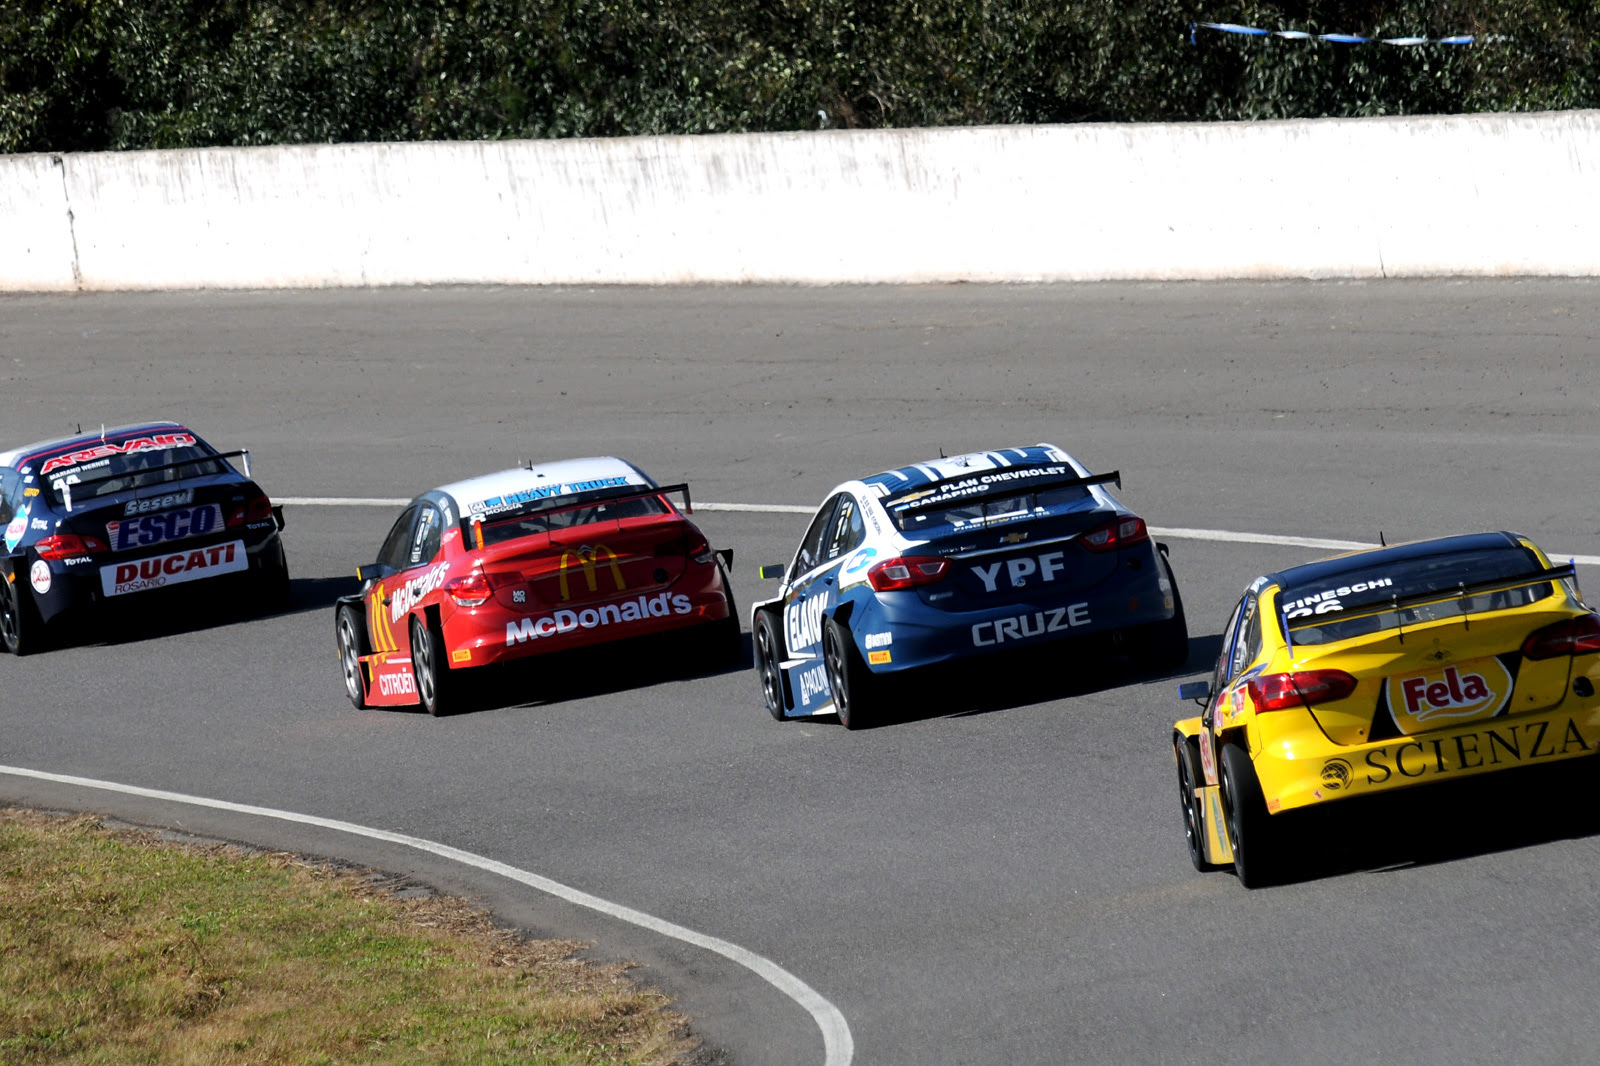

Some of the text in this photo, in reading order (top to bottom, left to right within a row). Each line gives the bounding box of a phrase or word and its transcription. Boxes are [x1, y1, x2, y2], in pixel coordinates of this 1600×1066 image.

[81, 459, 110, 471] WERNER
[940, 466, 1066, 493] PLAN CHEVROLET
[504, 476, 629, 505] HEAVY TRUCK
[909, 484, 990, 508] CANAPINO
[485, 502, 523, 516] MOGGIA
[117, 505, 216, 549] ESCO
[64, 556, 92, 567] TOTAL
[115, 543, 236, 585] DUCATI
[970, 551, 1065, 592] YPF
[114, 576, 166, 594] ROSARIO
[1282, 578, 1393, 613] FINESCHI
[506, 592, 692, 647] McDonald's
[971, 602, 1092, 647] CRUZE
[1402, 664, 1490, 714] Fela
[1365, 717, 1592, 785] SCIENZA
